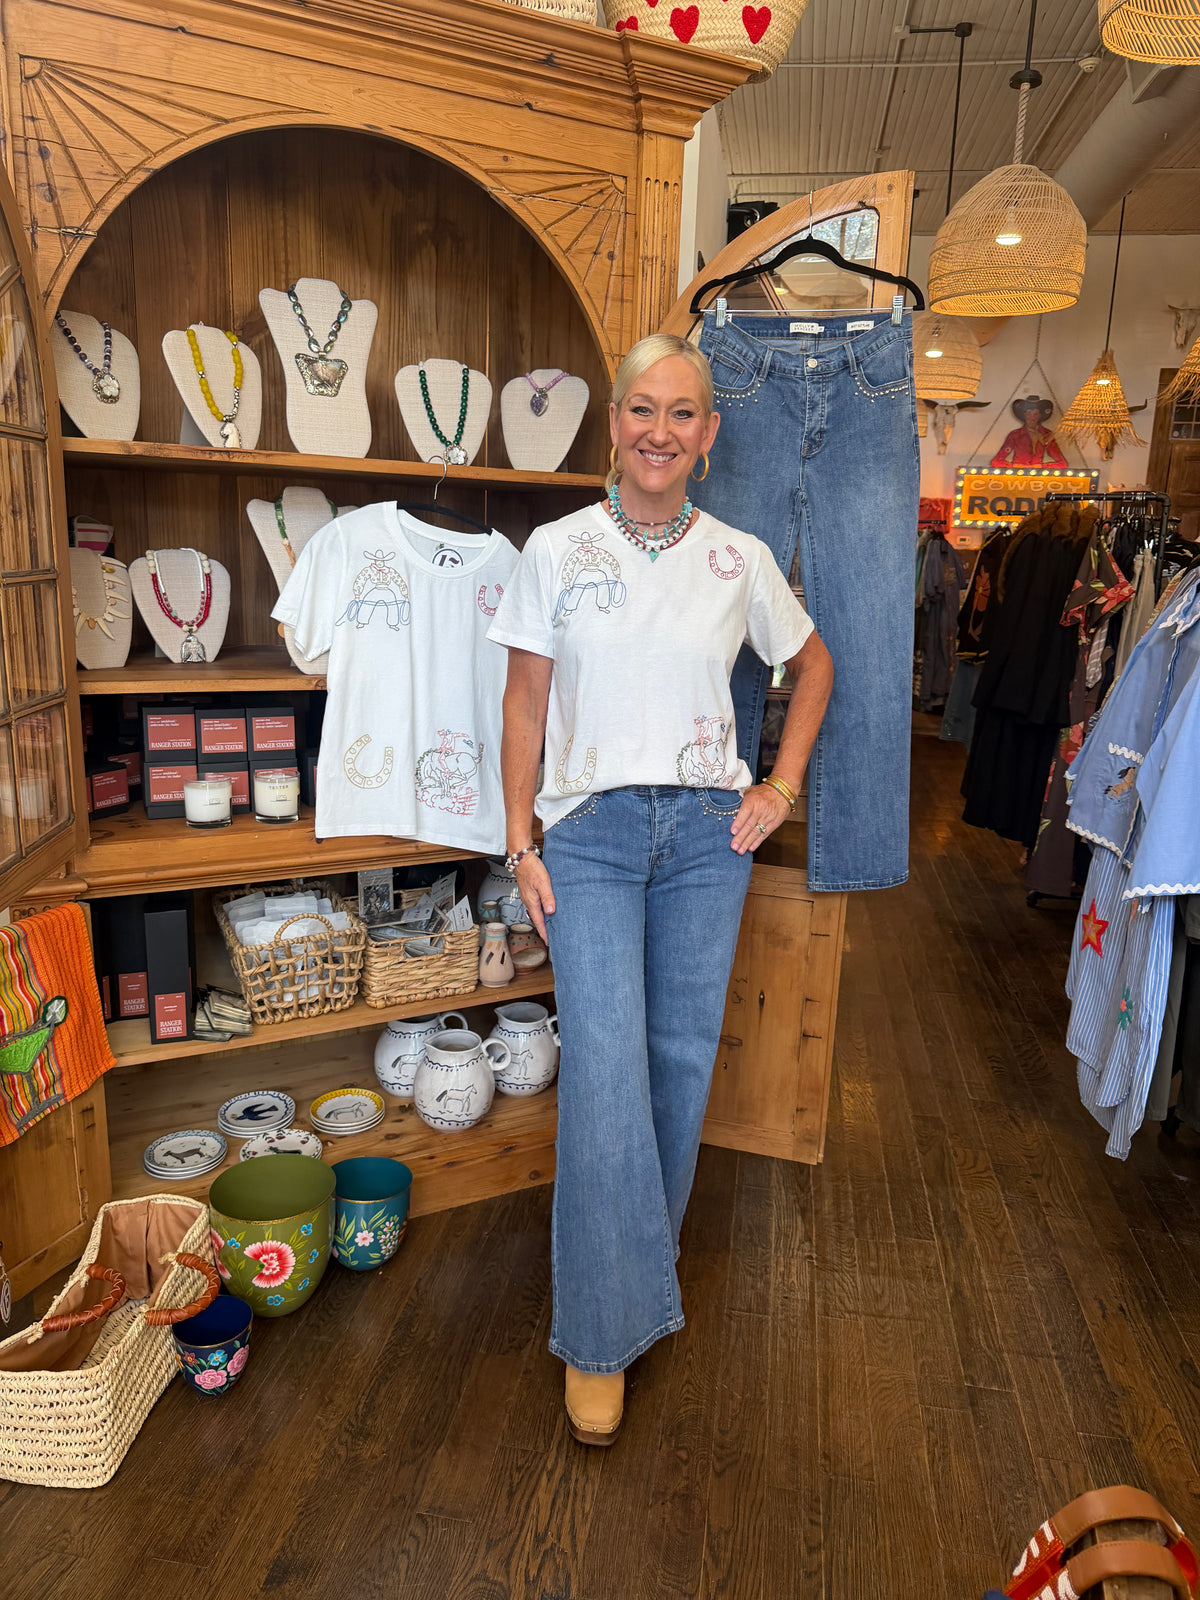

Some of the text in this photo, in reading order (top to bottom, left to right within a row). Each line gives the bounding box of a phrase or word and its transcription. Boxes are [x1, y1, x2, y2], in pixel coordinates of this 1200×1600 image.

[970, 479, 1084, 493] COWBOY
[968, 495, 1048, 515] ROD
[96, 799, 111, 807] RANGER
[160, 1019, 182, 1027] RANGER
